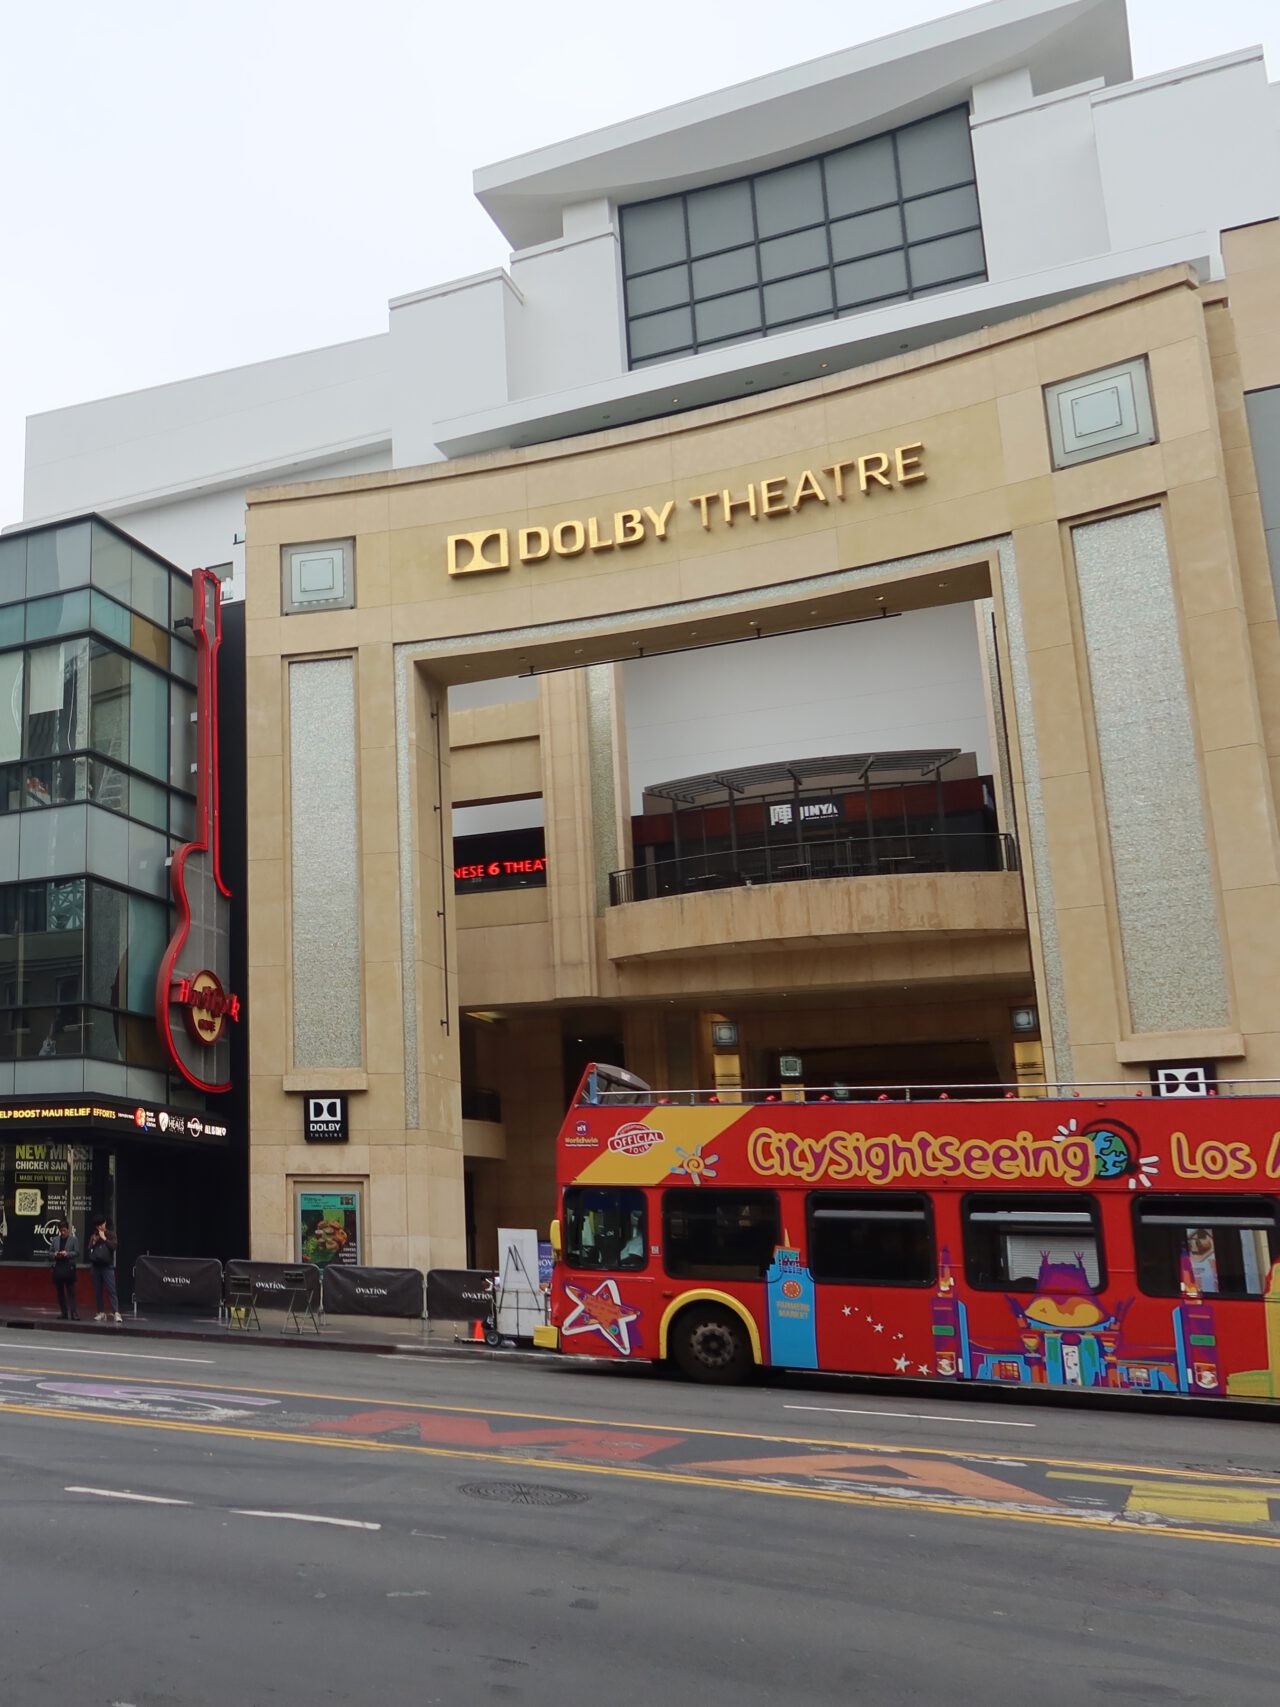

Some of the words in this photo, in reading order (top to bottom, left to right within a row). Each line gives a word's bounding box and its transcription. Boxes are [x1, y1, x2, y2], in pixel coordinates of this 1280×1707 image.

[519, 501, 676, 563] DOLBY
[689, 442, 927, 532] THEATRE
[800, 803, 839, 820] JINYA
[488, 862, 500, 875] 6
[13, 1109, 40, 1118] BOOST
[41, 1108, 63, 1117] MAUI
[64, 1107, 91, 1117] RELIEF
[93, 1108, 116, 1119] EFFORTS
[310, 1123, 341, 1131] DOLBY
[613, 1132, 659, 1149] OFFICIAL
[15, 1145, 47, 1160] NEW
[49, 1144, 93, 1160] MSSI
[628, 1143, 650, 1154] TOUR
[747, 1126, 1096, 1187] CitySightseeing
[1170, 1131, 1258, 1180] Los
[15, 1160, 49, 1170] CHICKEN
[50, 1160, 93, 1171] SANWICH
[33, 1225, 55, 1235] Hard
[162, 1276, 191, 1285] OVATION
[255, 1280, 286, 1290] OVATION
[355, 1286, 388, 1296] OVATION
[778, 1310, 808, 1319] MARKET
